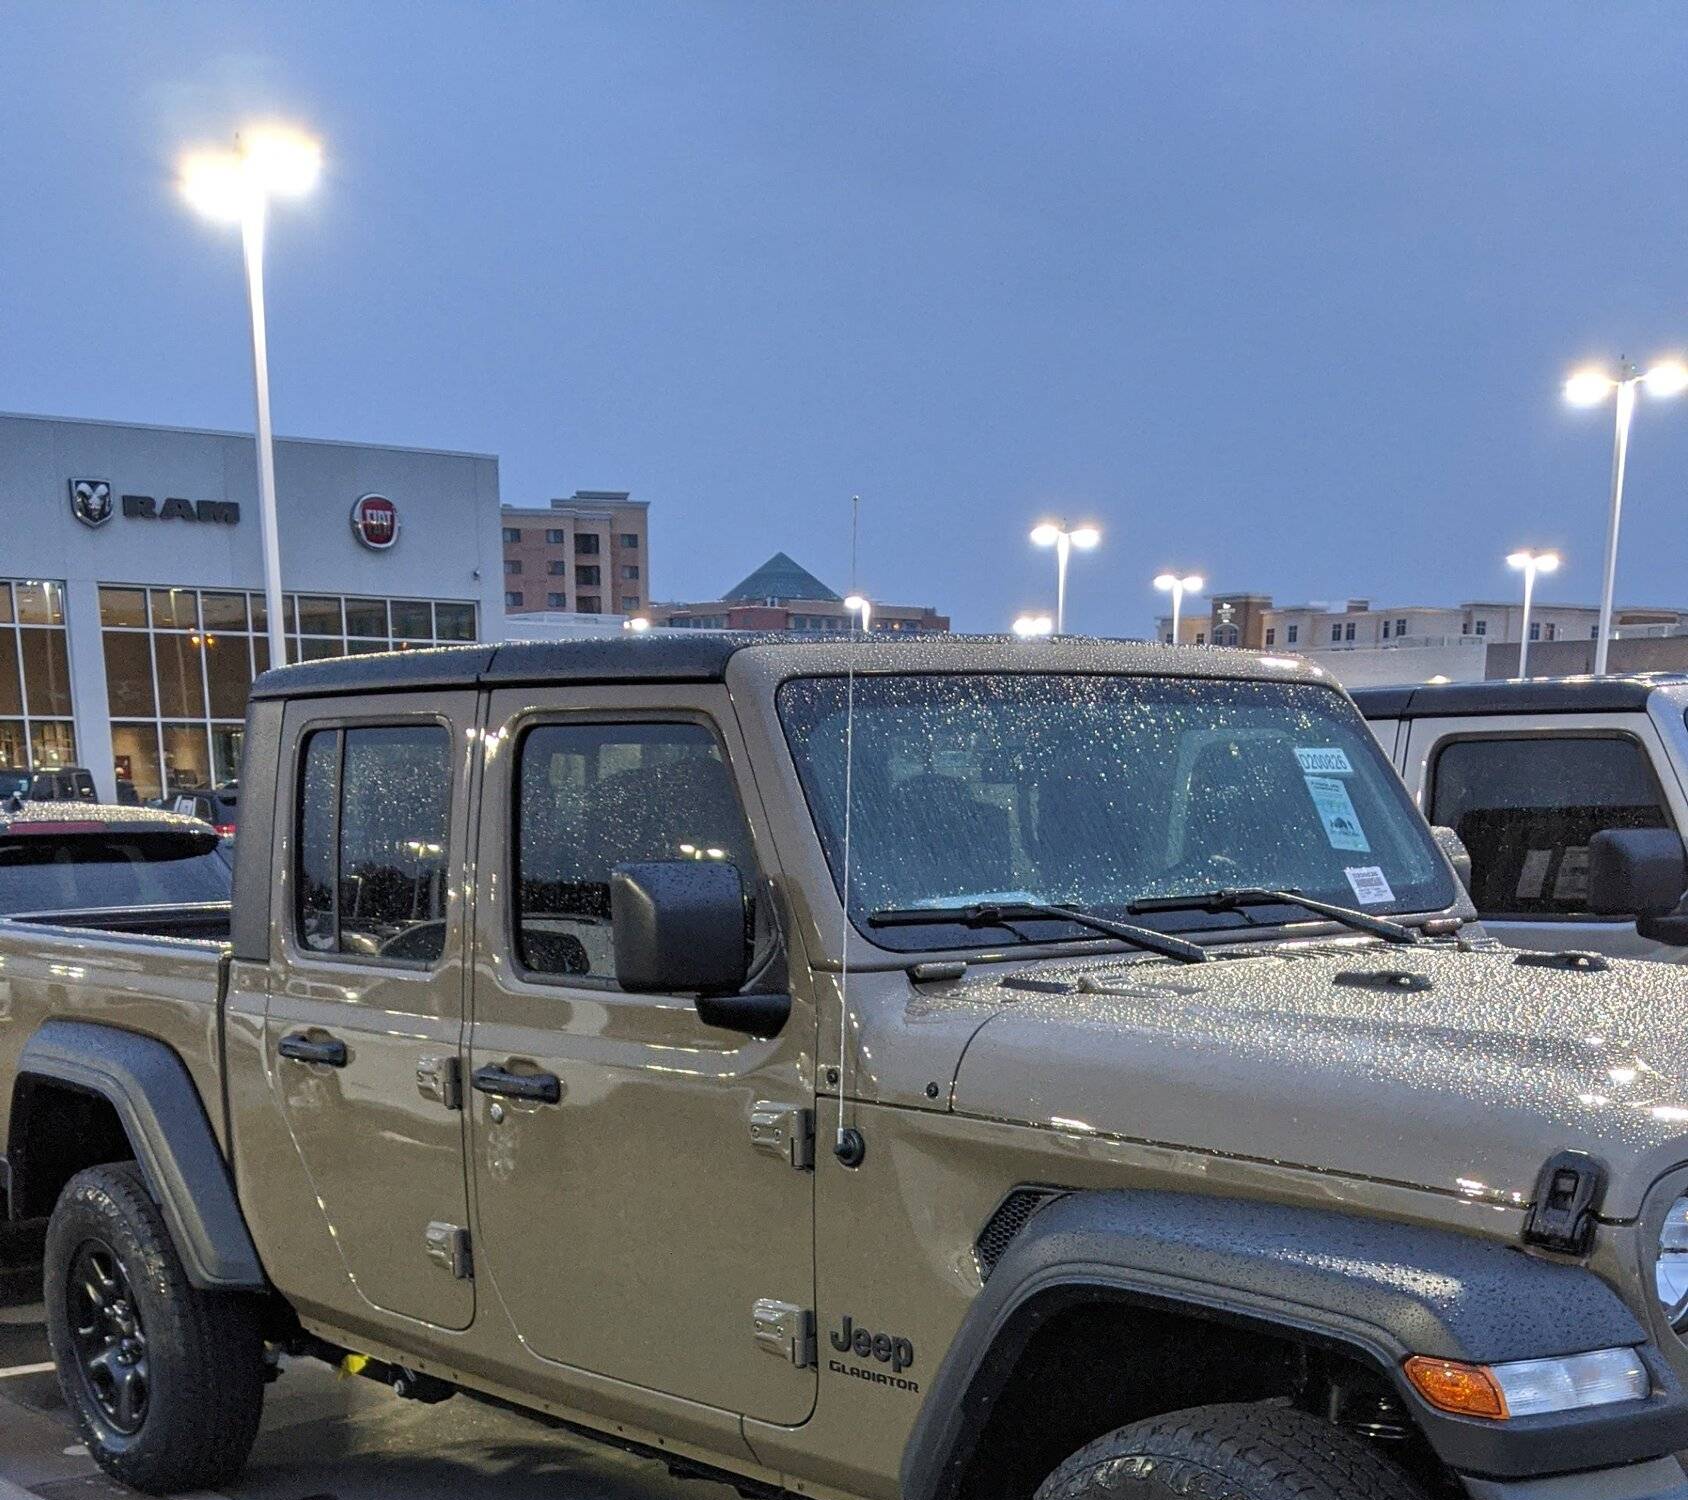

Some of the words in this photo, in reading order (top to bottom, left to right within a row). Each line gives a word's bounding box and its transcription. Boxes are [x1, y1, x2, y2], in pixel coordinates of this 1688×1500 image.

[122, 494, 240, 524] RAM
[364, 508, 393, 536] FIAT
[829, 1315, 914, 1373] Jeep
[829, 1360, 920, 1393] GLADIATOR
